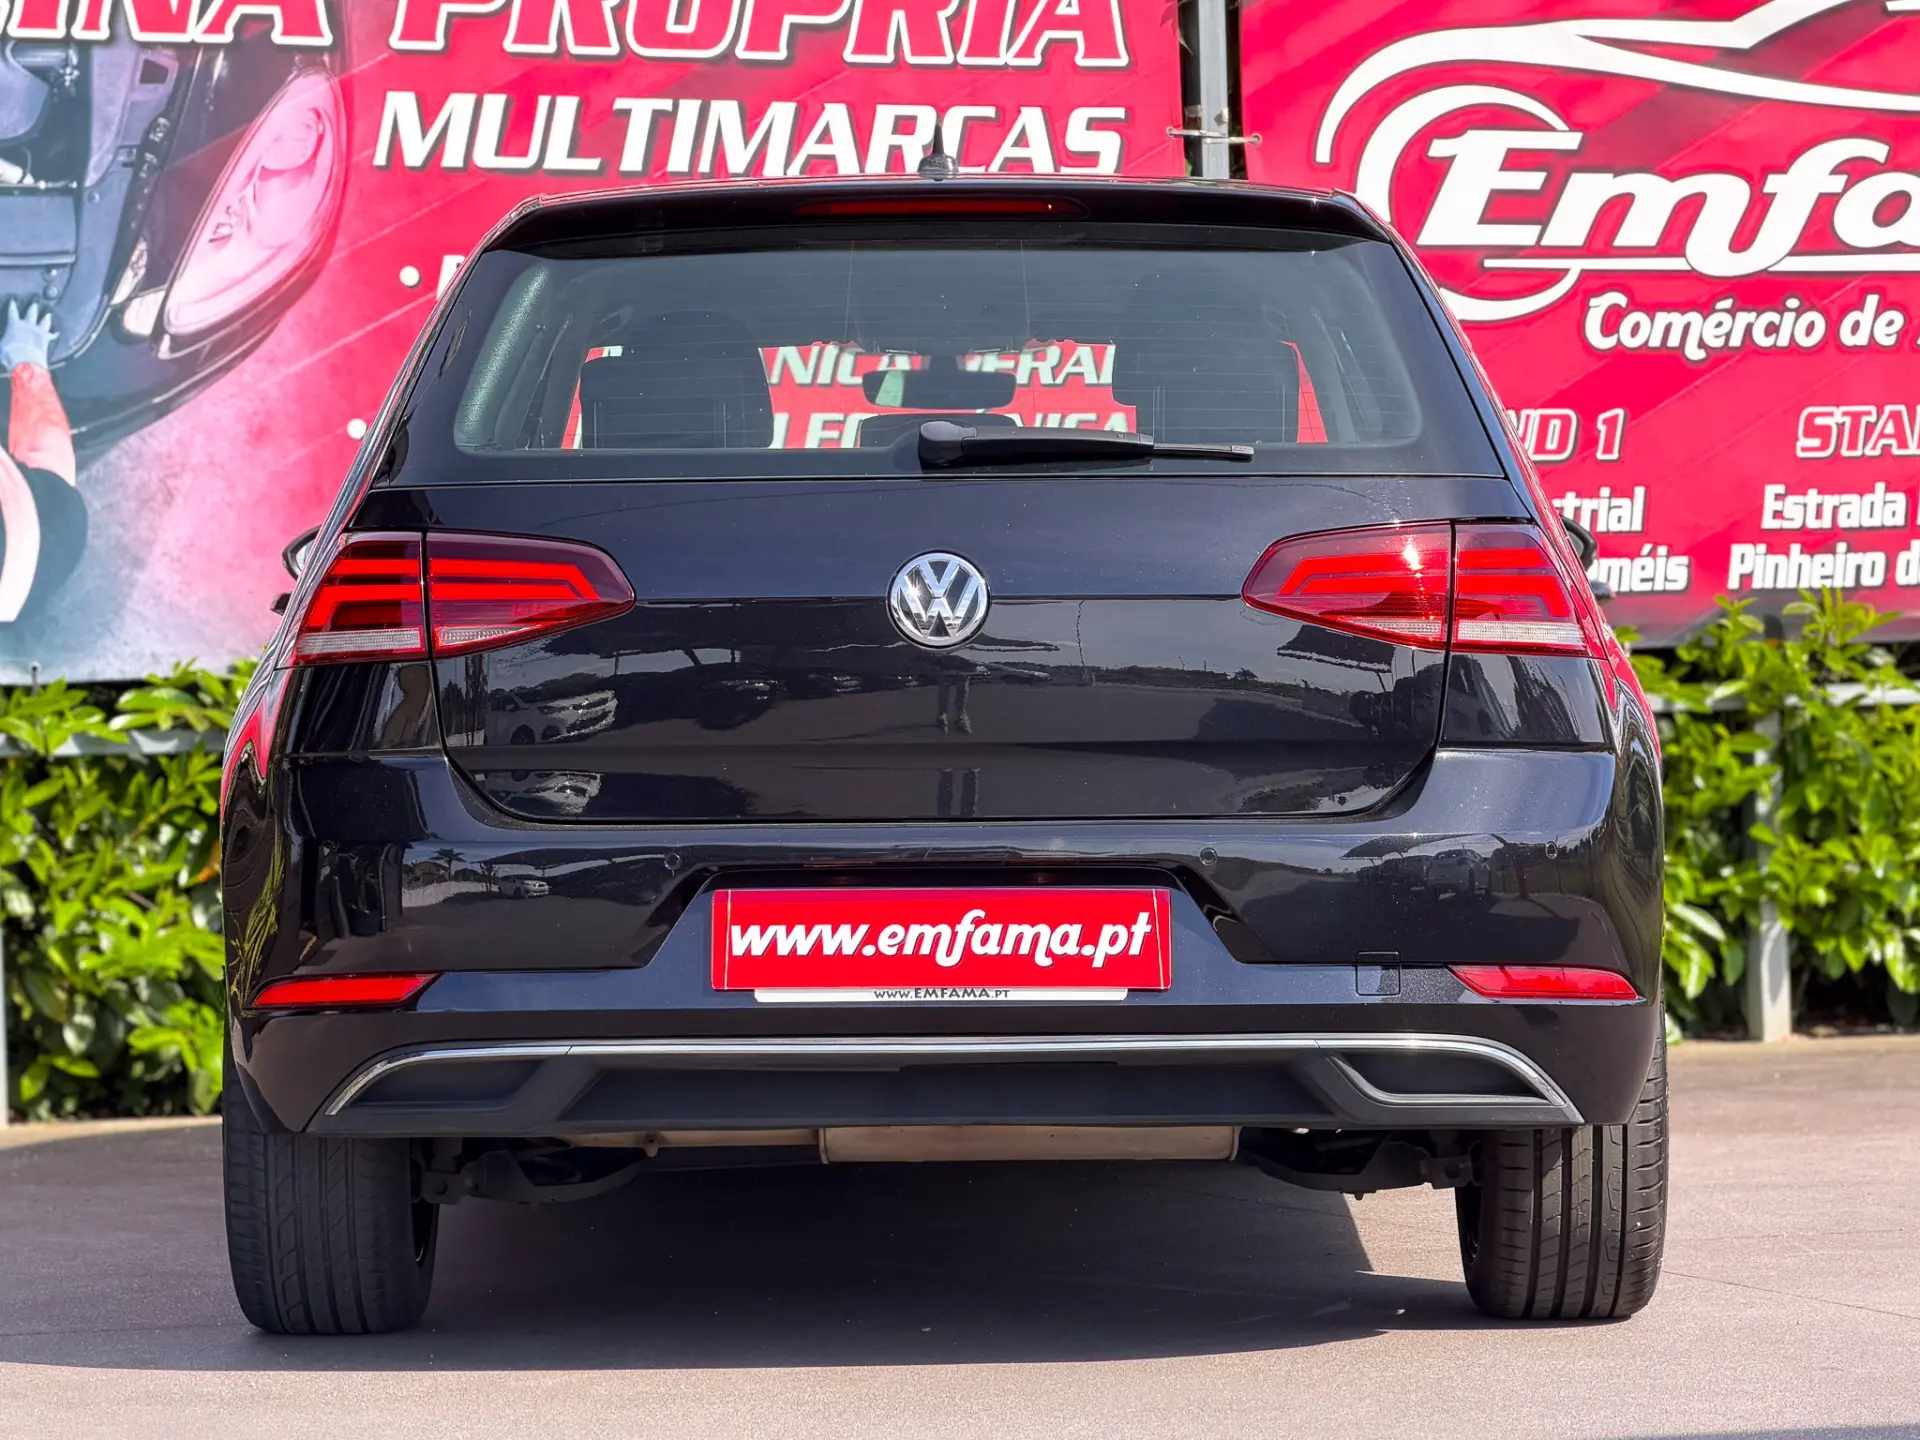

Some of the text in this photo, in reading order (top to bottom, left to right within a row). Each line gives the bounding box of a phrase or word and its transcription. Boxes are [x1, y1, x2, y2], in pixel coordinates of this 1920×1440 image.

[373, 91, 1126, 175] MULTIMARCAS
[1584, 290, 1905, 361] Comércio de
[1596, 408, 1625, 461] 1
[1796, 403, 1920, 459] STA
[1552, 485, 1646, 532] trial
[1760, 481, 1907, 530] Estrada
[1727, 541, 1888, 590] Pinheiro
[731, 908, 1153, 968] www.emfama.pt
